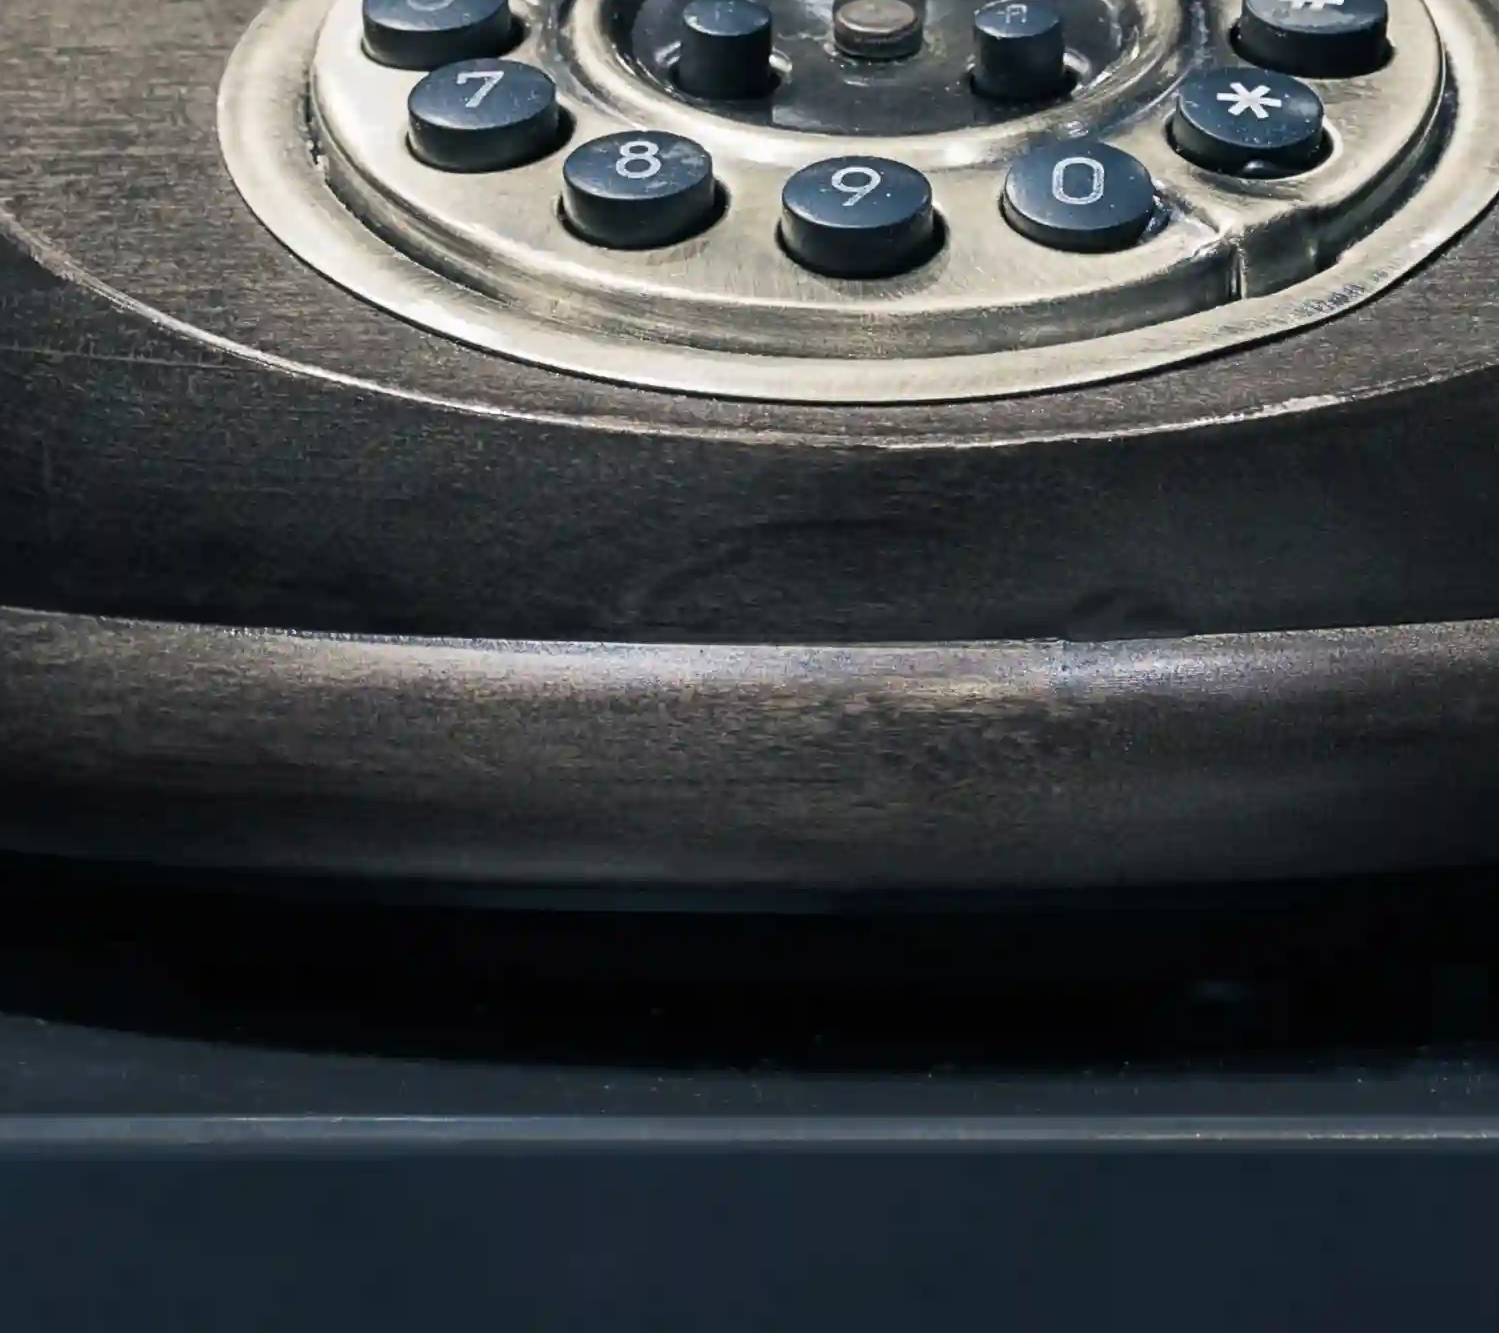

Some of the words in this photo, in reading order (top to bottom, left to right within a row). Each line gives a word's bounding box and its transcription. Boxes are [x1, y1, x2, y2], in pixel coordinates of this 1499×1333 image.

[456, 71, 504, 108] 7
[616, 140, 661, 179] 8
[831, 166, 881, 207] 9
[1052, 156, 1105, 205] 0
